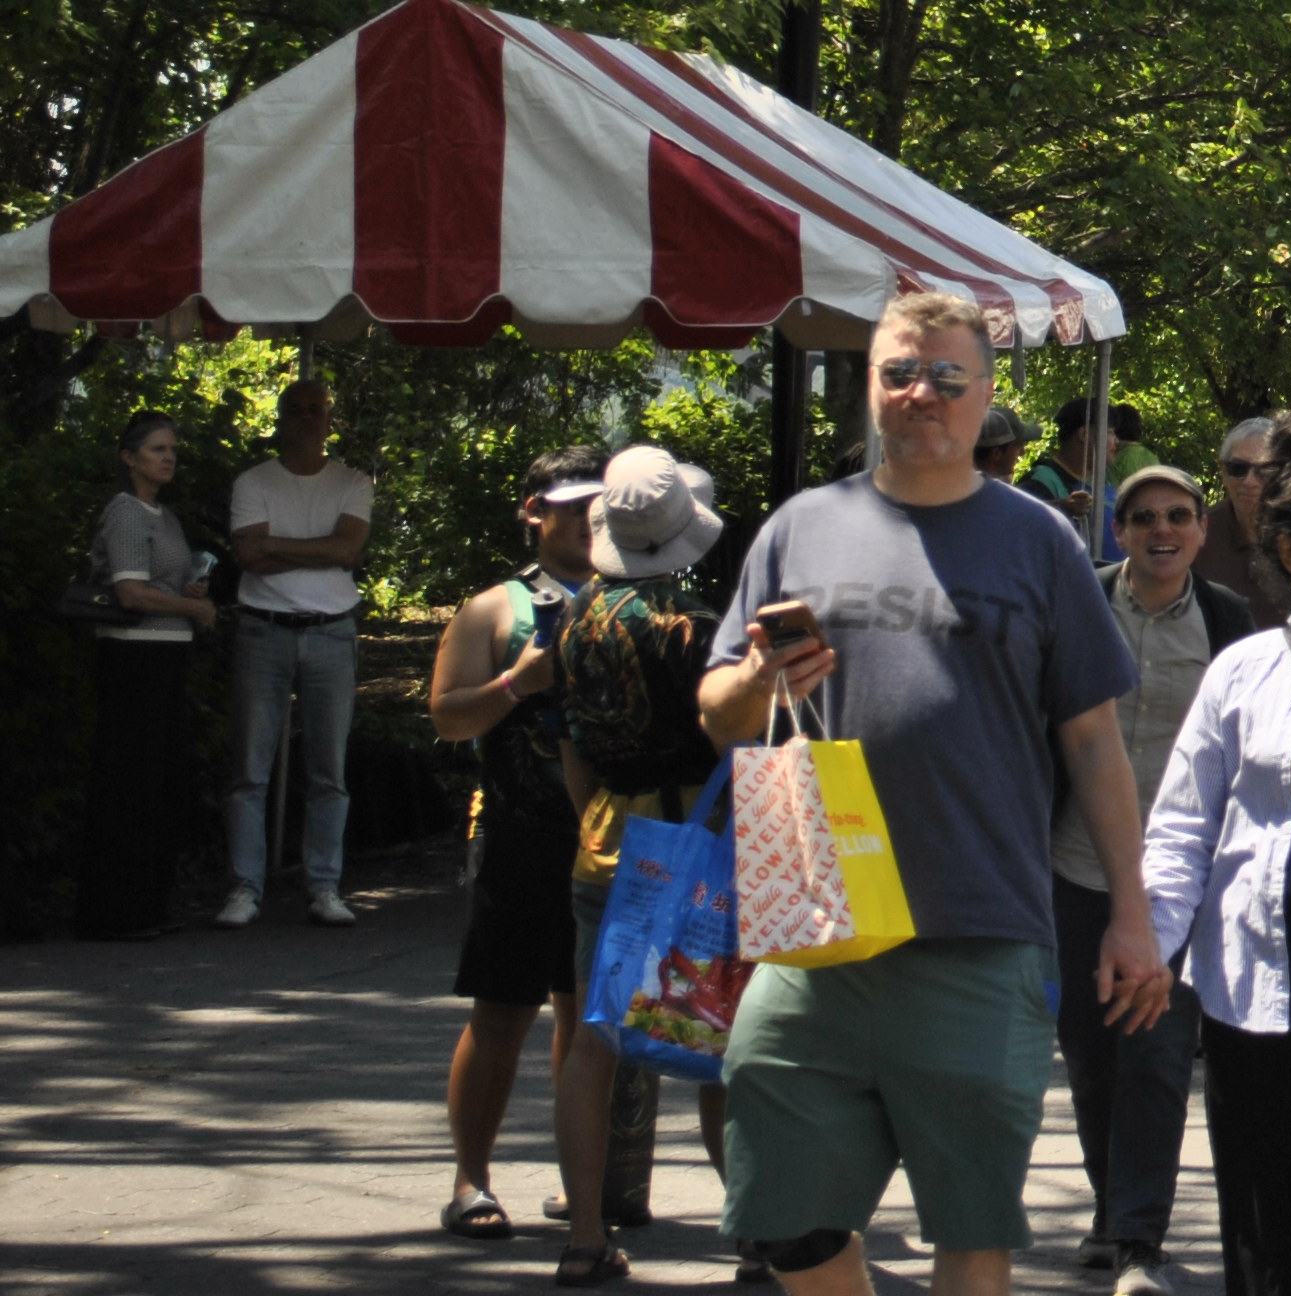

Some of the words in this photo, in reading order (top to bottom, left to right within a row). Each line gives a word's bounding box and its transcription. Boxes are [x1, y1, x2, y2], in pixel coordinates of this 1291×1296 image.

[739, 850, 783, 901] LLOW
[752, 884, 783, 920] Yalla
[781, 909, 810, 944] Yalla
